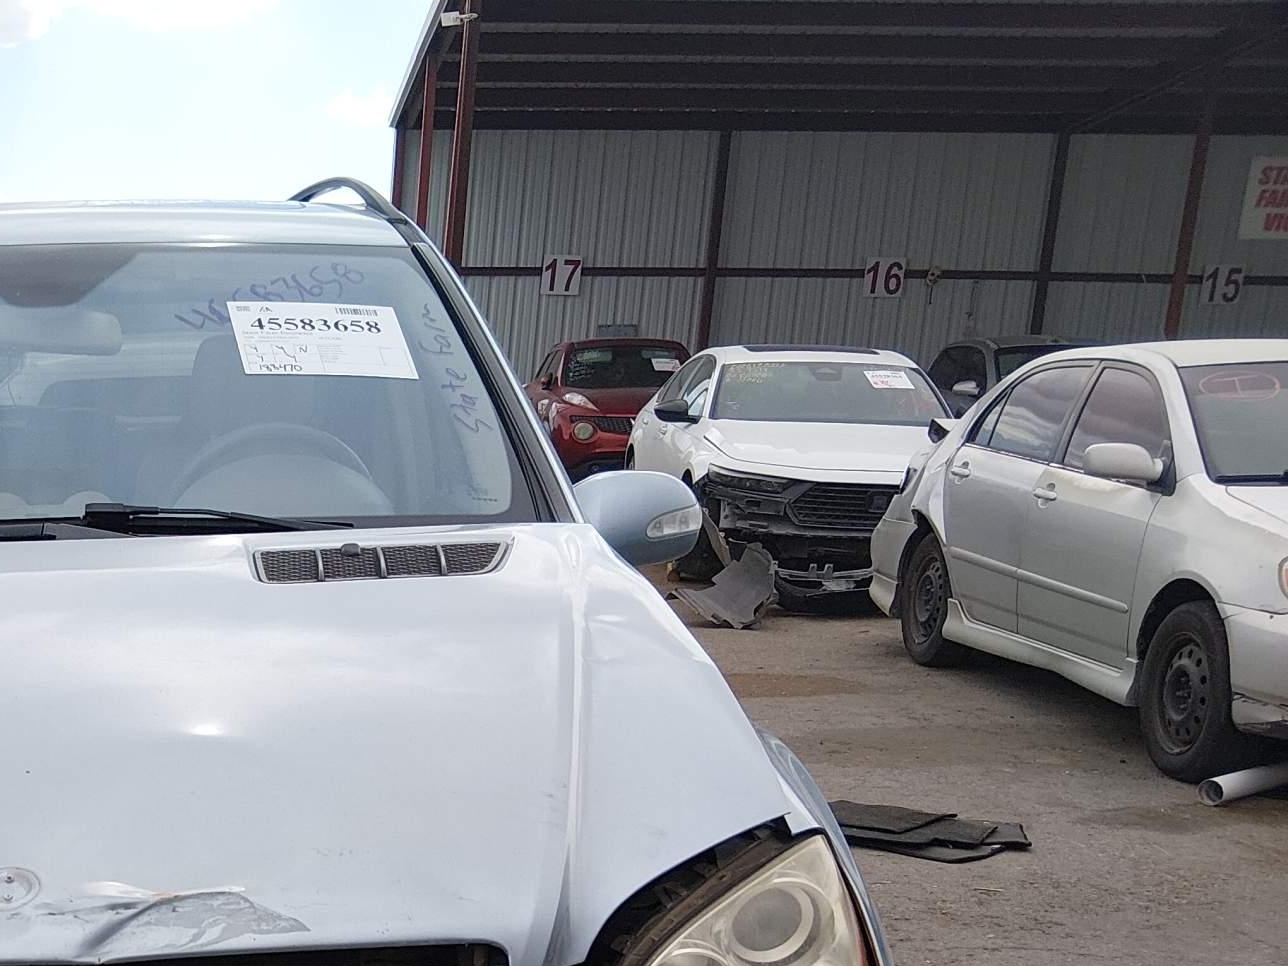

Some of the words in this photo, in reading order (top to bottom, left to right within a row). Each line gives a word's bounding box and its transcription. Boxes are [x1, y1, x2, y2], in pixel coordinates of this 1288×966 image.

[545, 258, 581, 292] 17
[867, 261, 903, 295] 16
[1206, 266, 1242, 302] 15
[250, 317, 382, 335] 45583658
